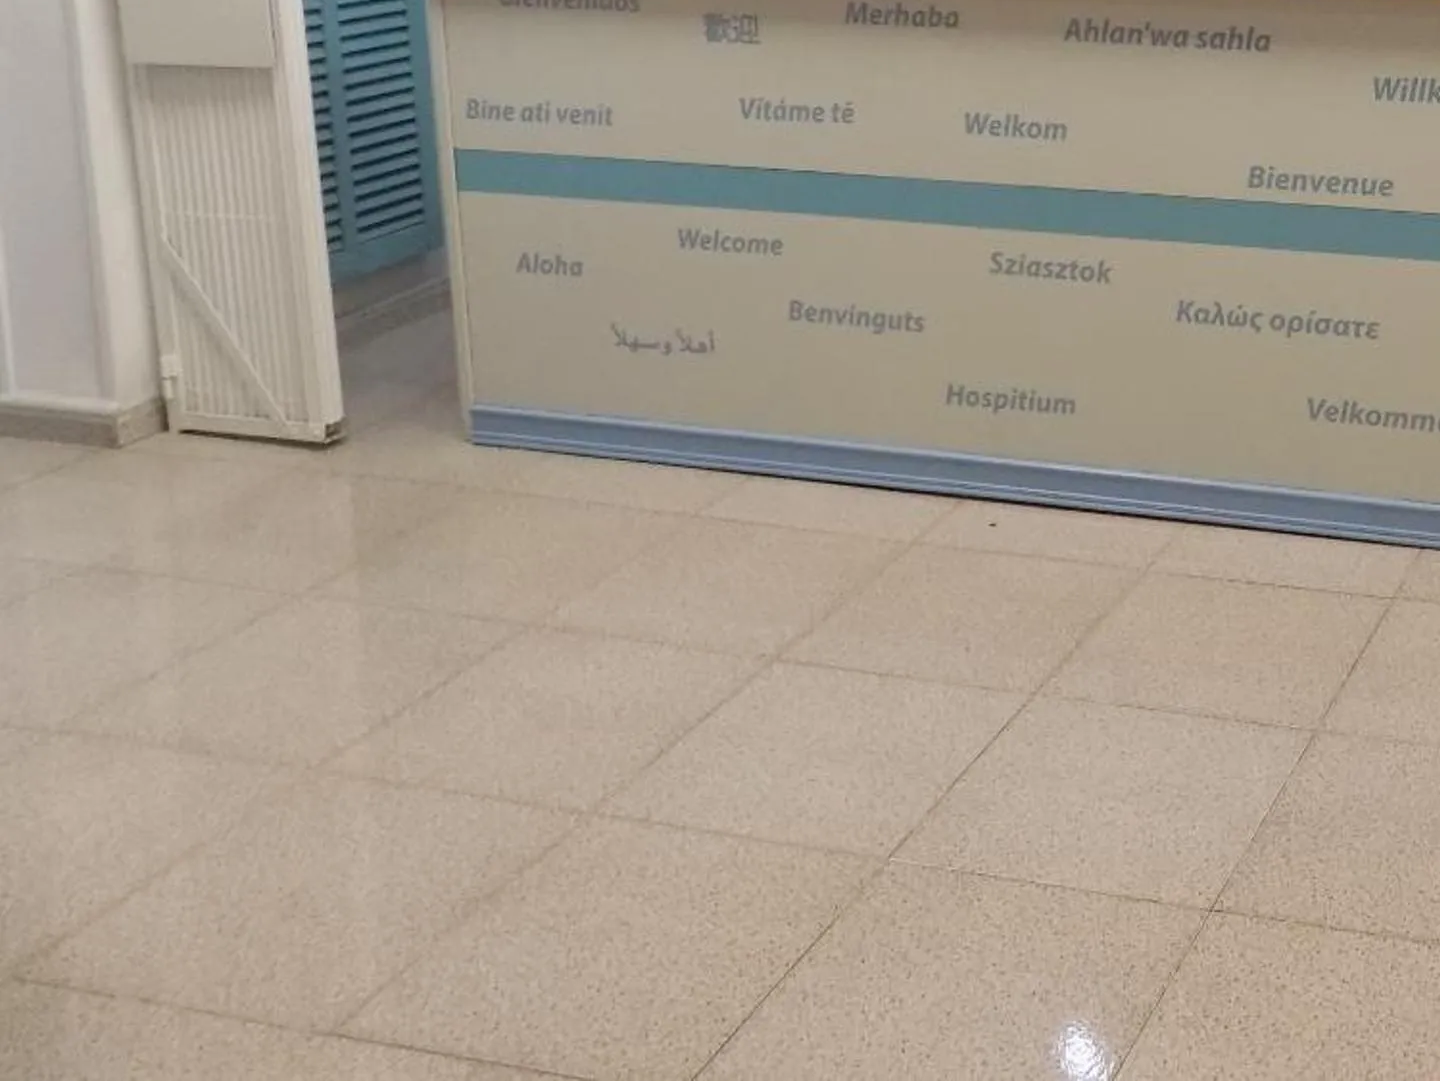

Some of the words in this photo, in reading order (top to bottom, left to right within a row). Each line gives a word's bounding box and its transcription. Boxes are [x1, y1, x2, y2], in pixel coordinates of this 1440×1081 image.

[845, 1, 960, 29] Merhaba
[1195, 25, 1271, 52] sahla
[466, 98, 515, 121] Bine
[521, 101, 550, 124] ati
[556, 104, 613, 127] venit
[964, 112, 1068, 141] Welkom
[1247, 165, 1394, 197] Bienvenue
[677, 228, 784, 256] Welcome
[516, 252, 584, 277] Aloha
[989, 251, 1113, 283] Sziasztok
[788, 299, 926, 334] Benvinguts
[1176, 299, 1264, 333] Καλώς
[1269, 310, 1380, 340] ορίσατε
[945, 384, 1077, 415] Hospitium
